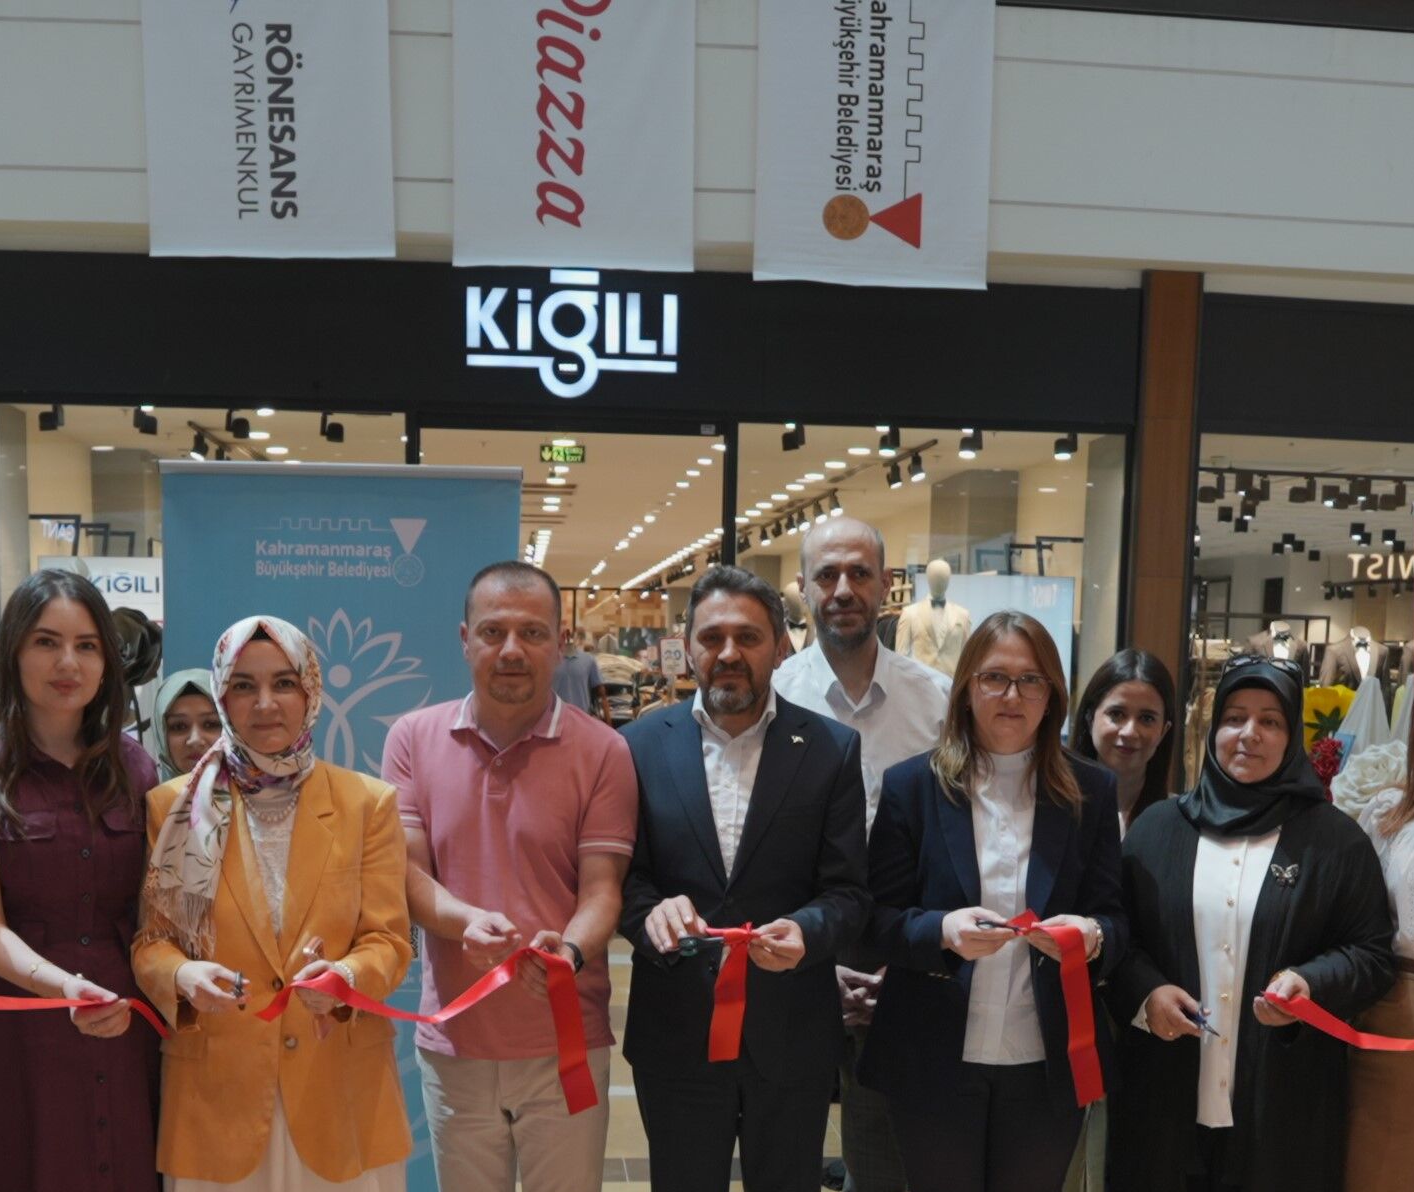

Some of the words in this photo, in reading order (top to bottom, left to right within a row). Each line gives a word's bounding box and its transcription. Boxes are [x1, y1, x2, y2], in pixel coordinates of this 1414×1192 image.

[231, 22, 261, 220] GAYRİMENKUL
[264, 22, 304, 220] RÖNESANS
[830, 93, 860, 192] Belediyesi
[859, 0, 893, 193] ahramanmaraş
[255, 539, 393, 562] Kahramanmaraş
[255, 559, 325, 580] Büyükşehir
[327, 560, 393, 581] Belediyesi
